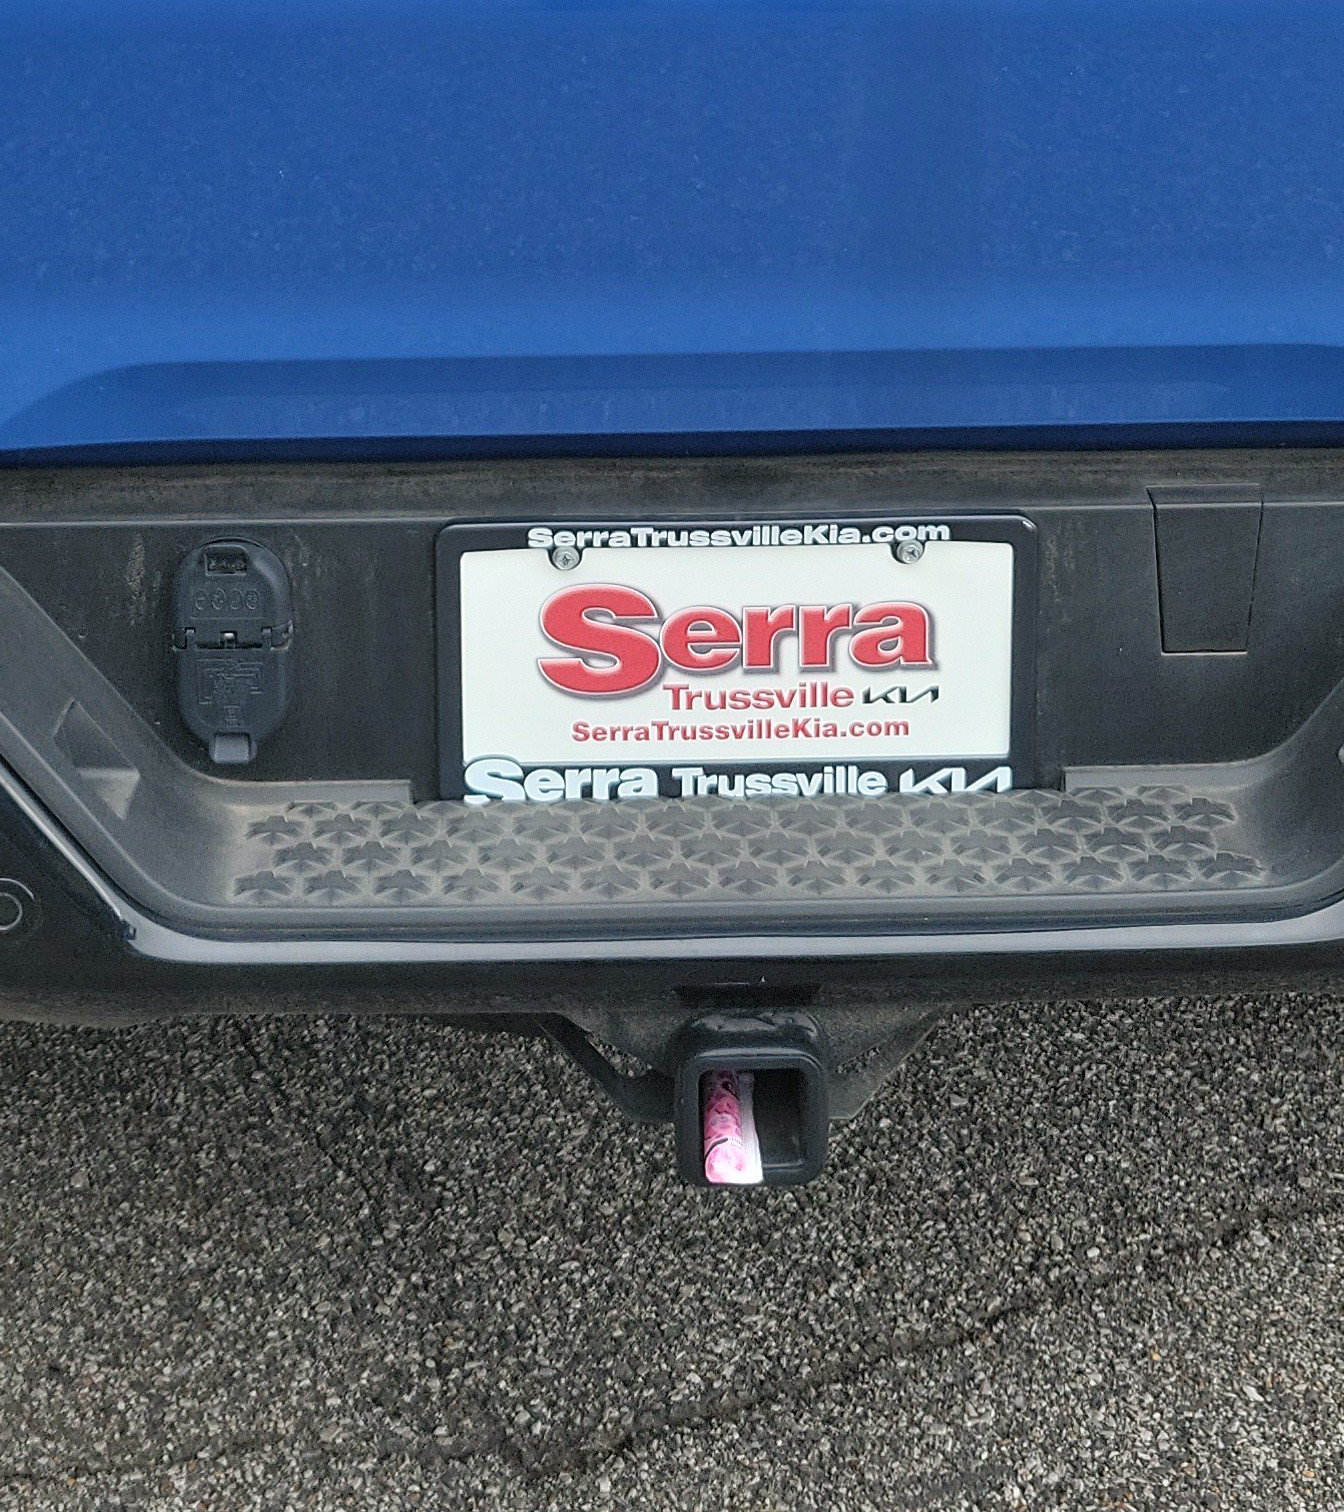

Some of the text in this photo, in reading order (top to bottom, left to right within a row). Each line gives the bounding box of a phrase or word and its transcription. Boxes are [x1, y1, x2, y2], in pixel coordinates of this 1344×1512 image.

[527, 522, 951, 549] SerraTrussvilleKia.com
[537, 582, 937, 696] Serra
[663, 682, 941, 711] Trussville KIA
[572, 716, 910, 741] SerraTrussvilleKia.com
[463, 755, 1012, 804] Serra Trussville KIA
